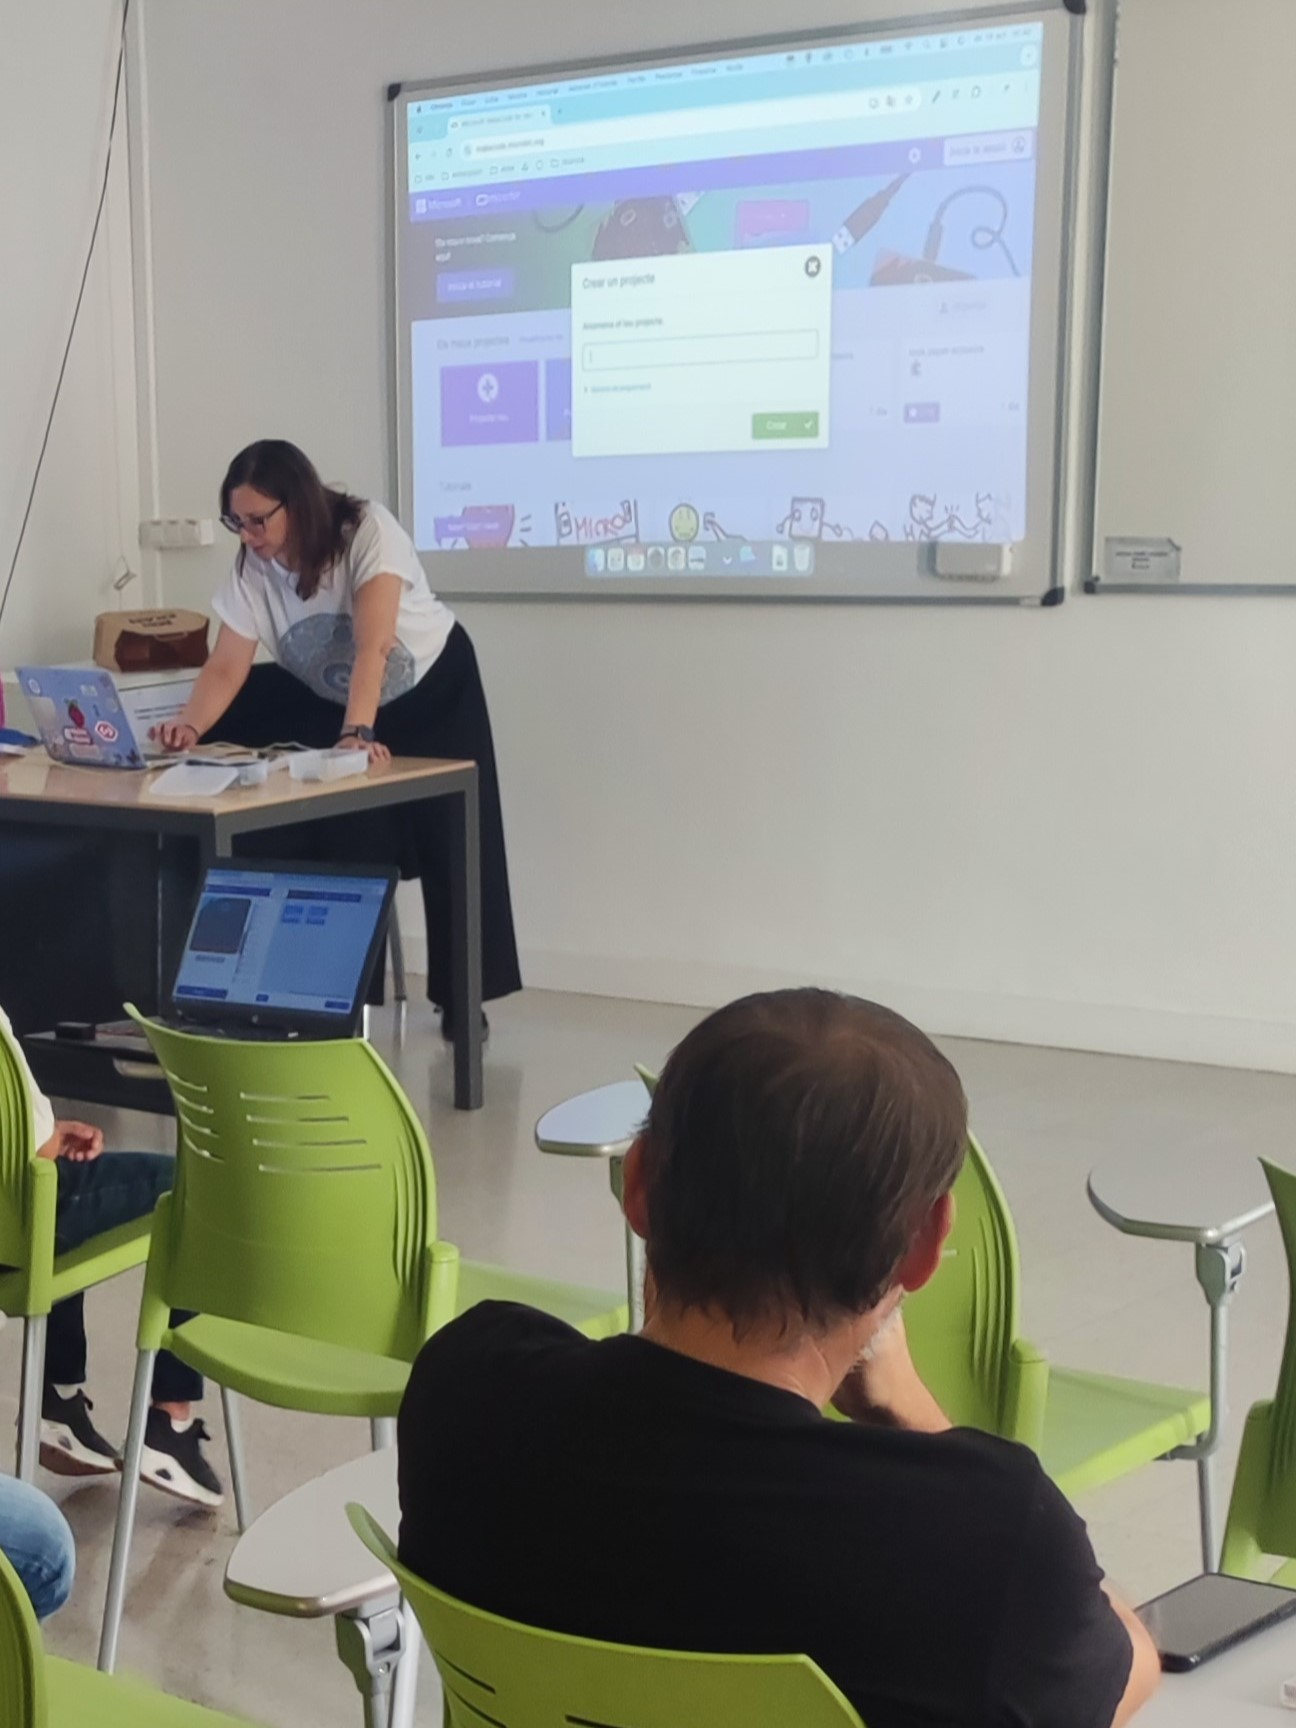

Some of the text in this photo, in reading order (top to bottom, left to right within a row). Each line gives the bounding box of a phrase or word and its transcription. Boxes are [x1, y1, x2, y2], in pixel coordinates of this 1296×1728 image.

[583, 273, 655, 289] Crear un projecte
